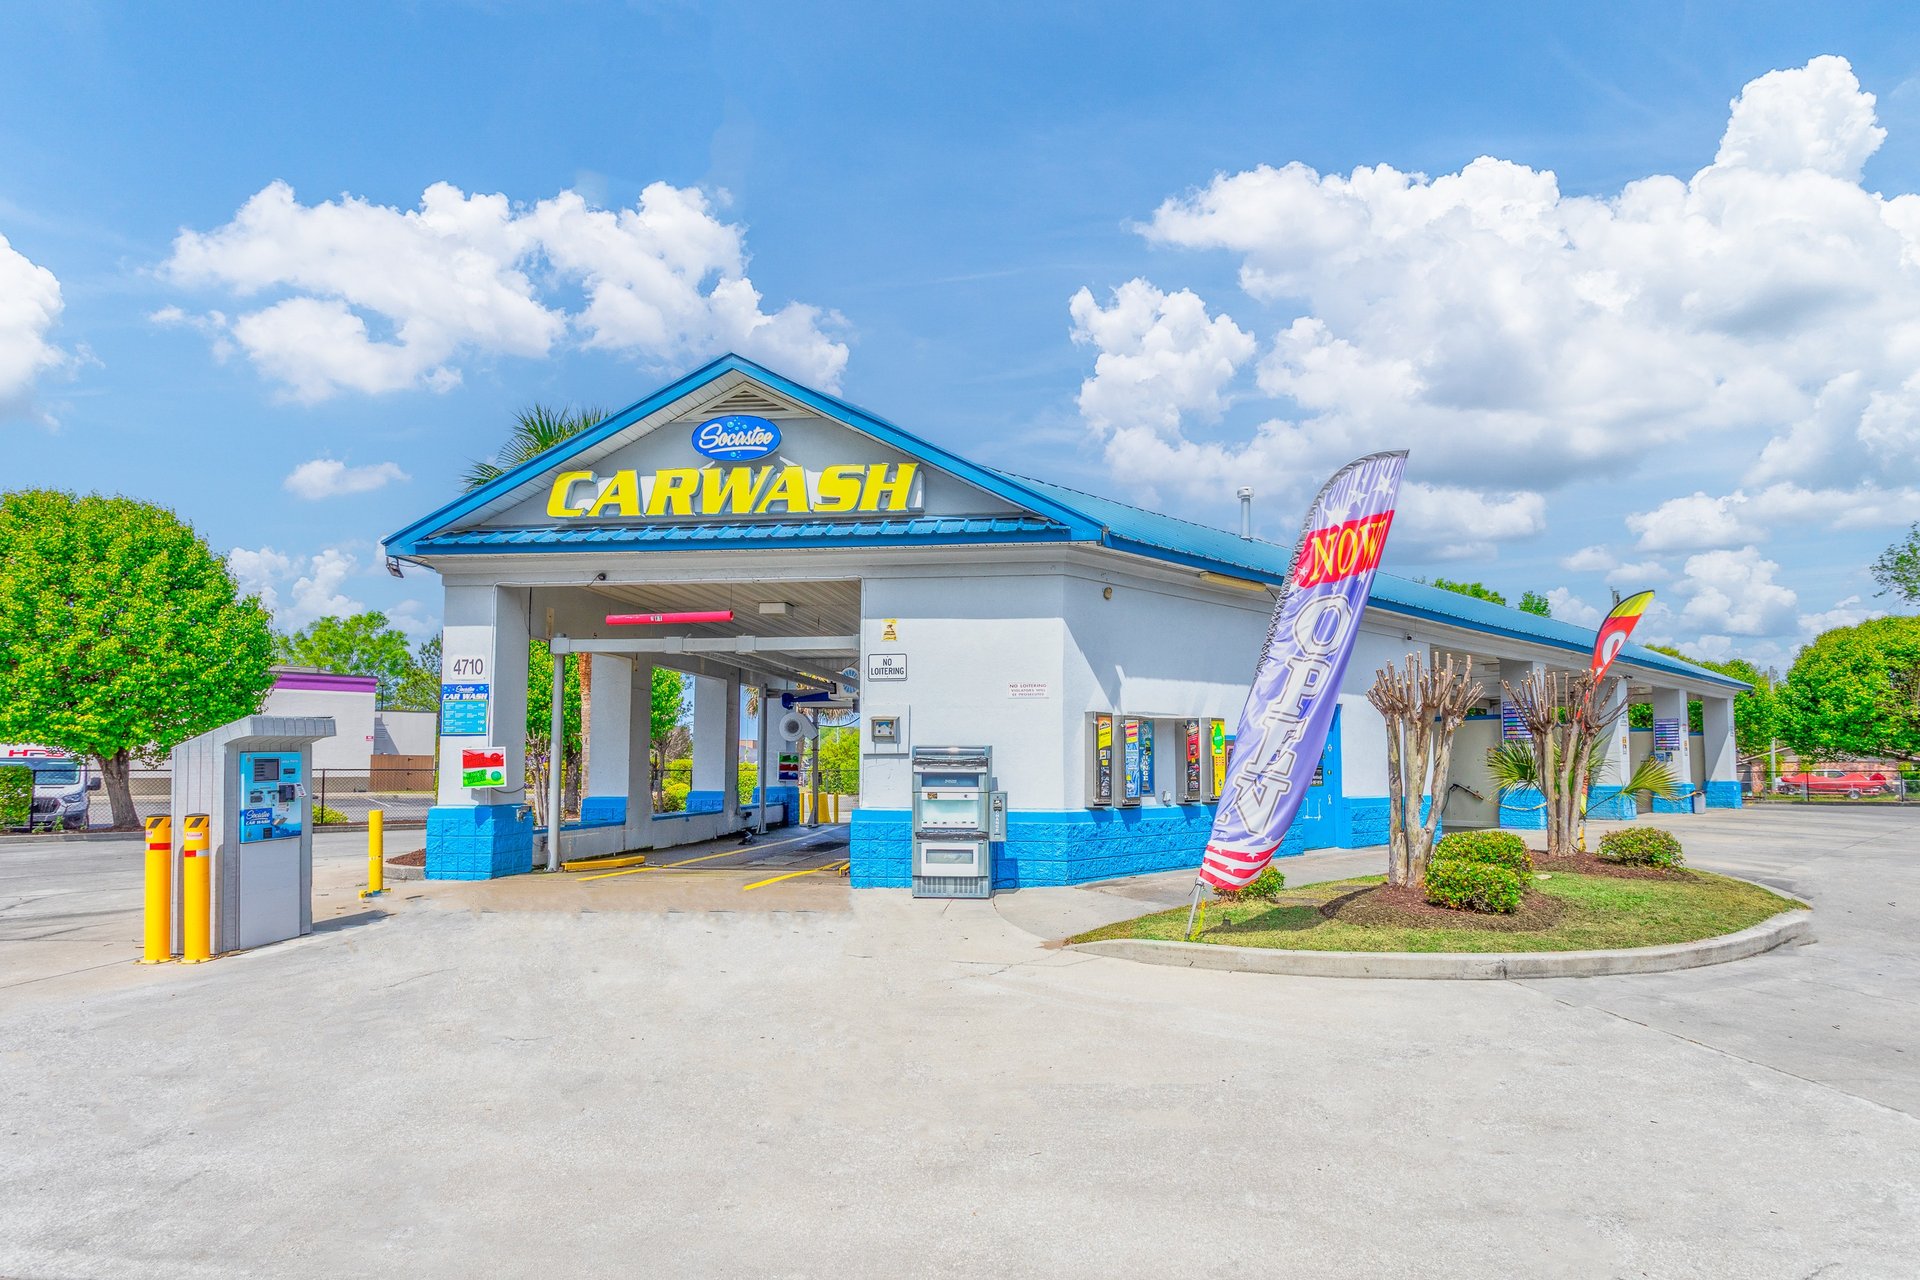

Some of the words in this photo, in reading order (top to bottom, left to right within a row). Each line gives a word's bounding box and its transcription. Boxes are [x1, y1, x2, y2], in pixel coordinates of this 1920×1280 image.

[698, 423, 774, 448] Socastee
[547, 463, 921, 517] CARWASH
[1309, 520, 1386, 582] NOW
[453, 658, 484, 676] 4710
[870, 667, 905, 676] LOITERING
[882, 658, 893, 667] NO
[1222, 595, 1352, 835] OPEN
